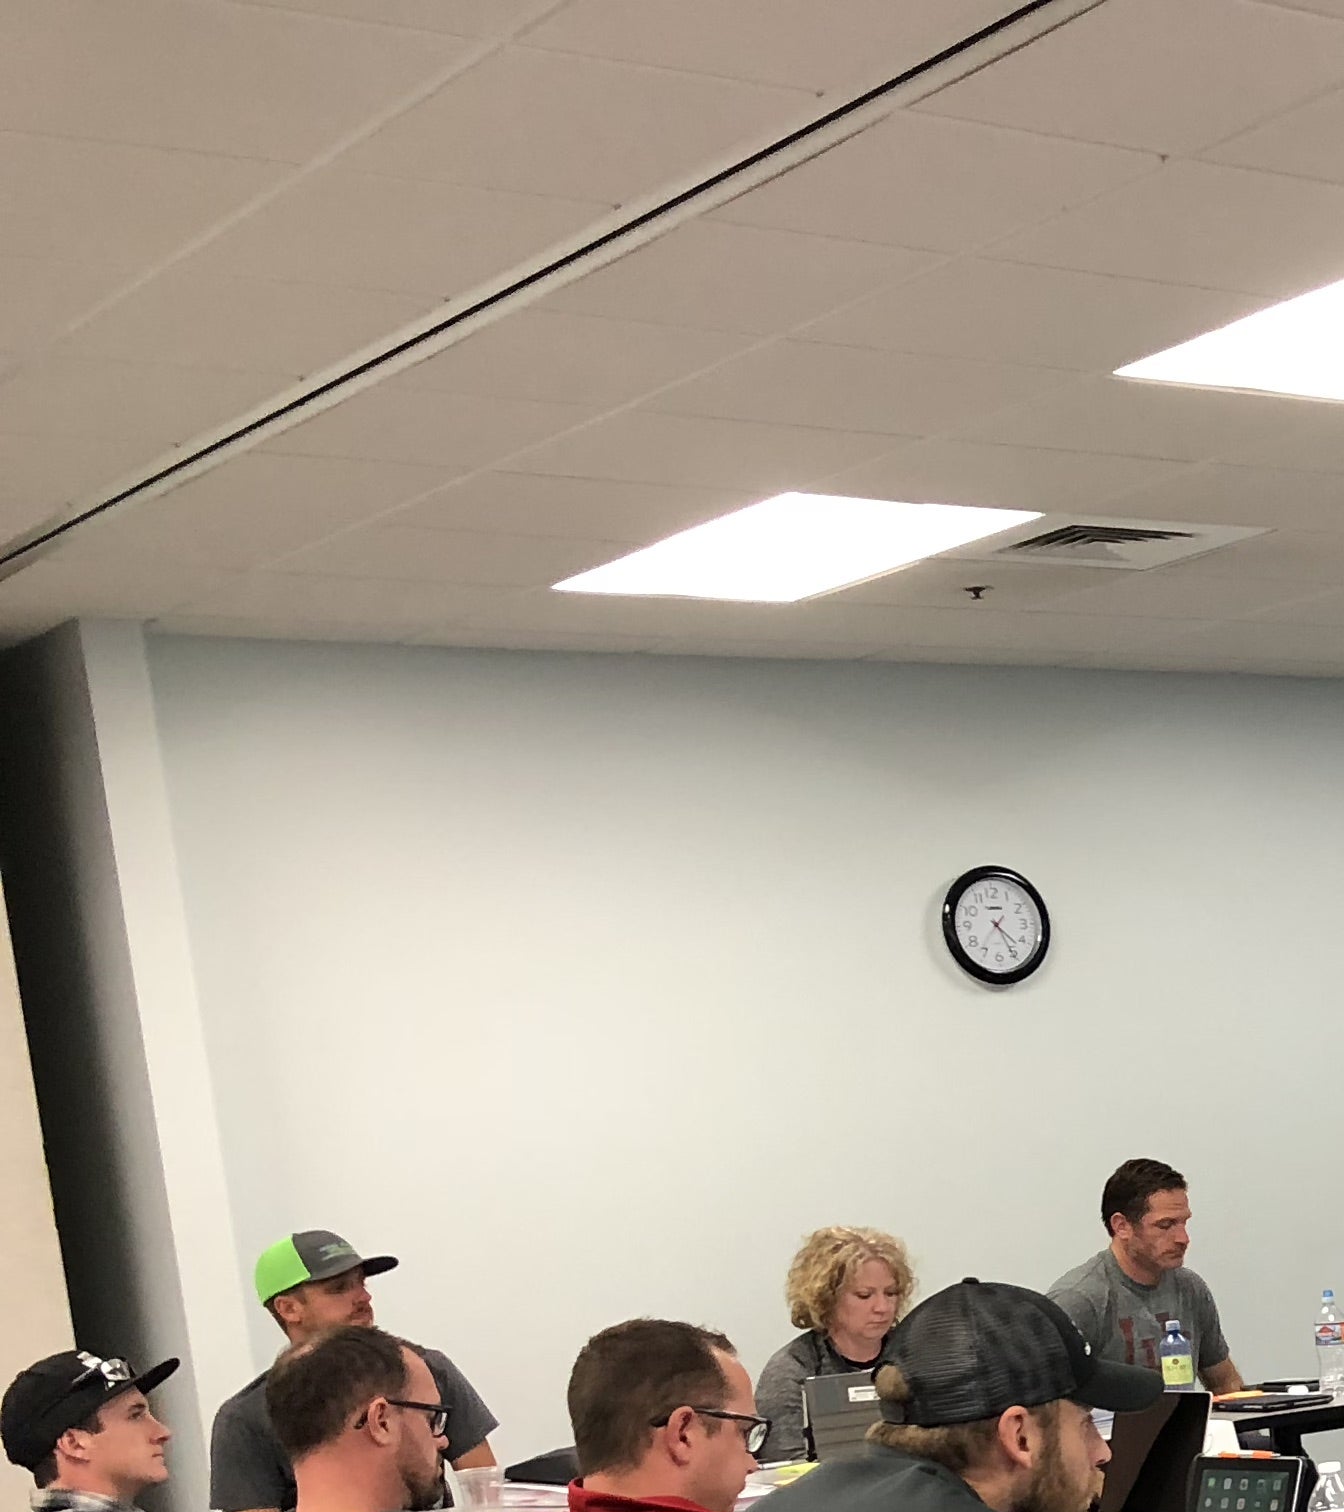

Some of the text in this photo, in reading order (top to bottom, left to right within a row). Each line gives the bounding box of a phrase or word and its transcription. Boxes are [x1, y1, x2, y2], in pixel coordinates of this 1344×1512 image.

[973, 893, 983, 904] 11
[984, 887, 998, 899] 12
[963, 905, 978, 917] 10
[1014, 903, 1023, 914] 2
[962, 920, 972, 931] 9
[1019, 918, 1028, 930] 3
[968, 935, 979, 947] 8
[1018, 935, 1026, 944] 4
[980, 947, 988, 958] 7
[995, 952, 1004, 962] 6
